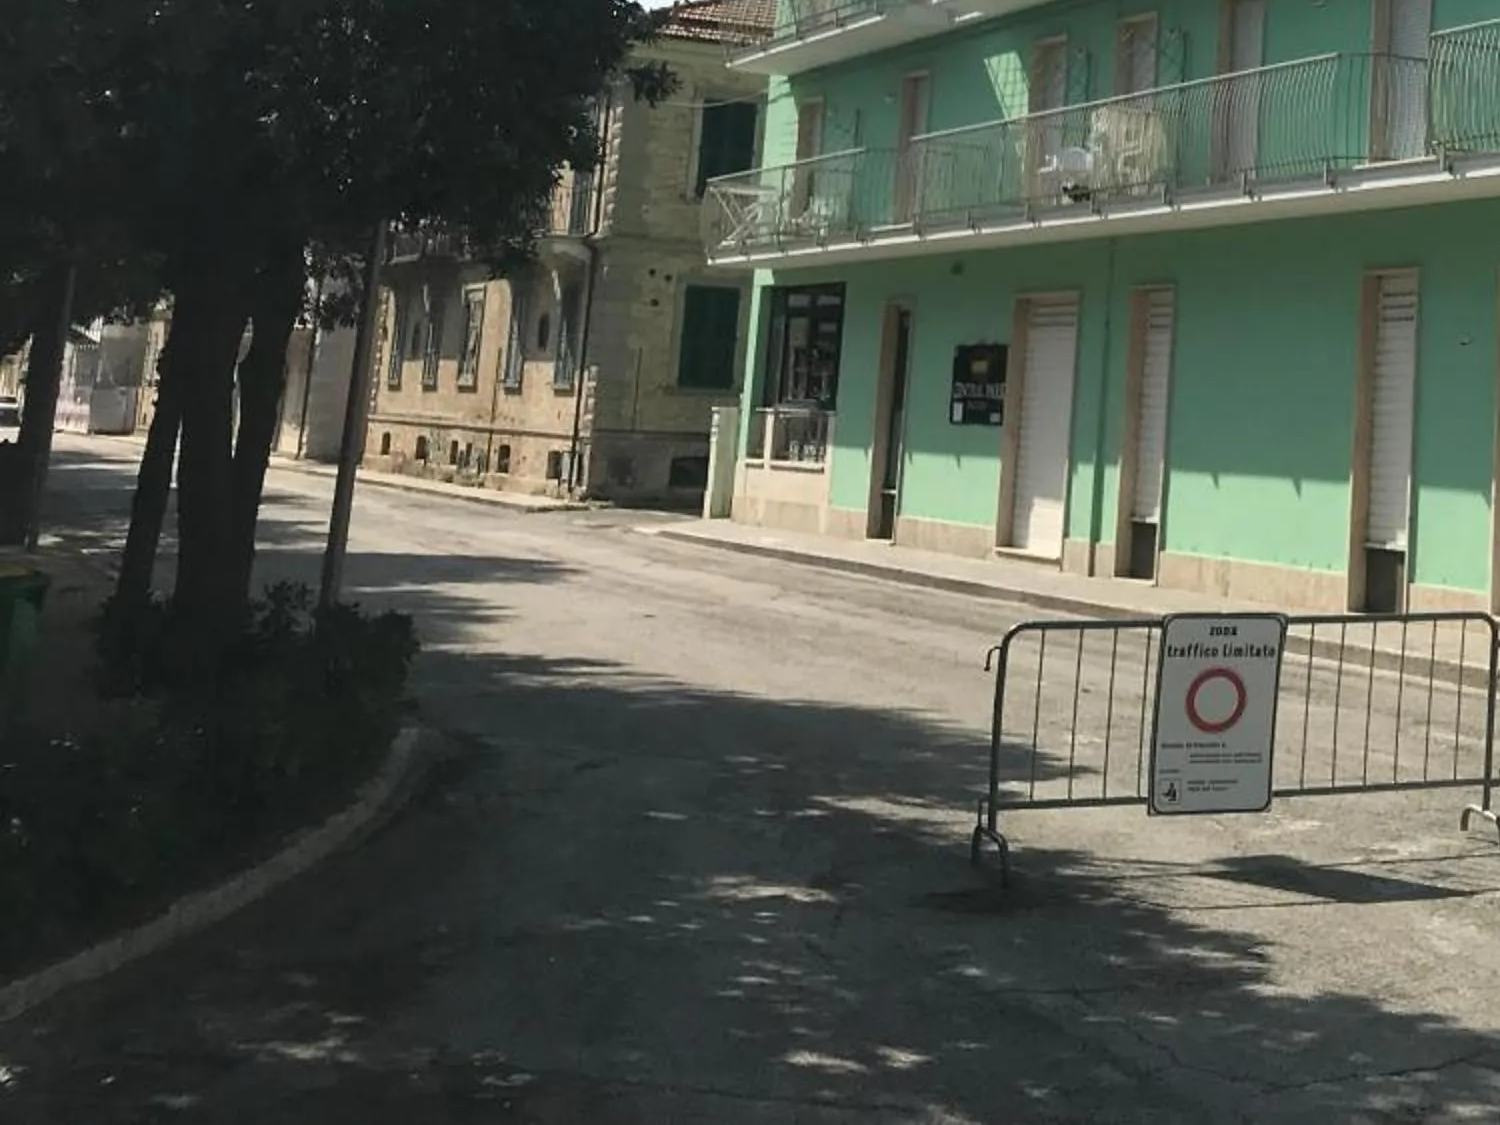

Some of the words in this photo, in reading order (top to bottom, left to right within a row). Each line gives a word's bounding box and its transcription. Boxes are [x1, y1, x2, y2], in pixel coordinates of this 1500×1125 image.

[1208, 626, 1238, 636] zona
[1167, 643, 1219, 658] traffico
[1223, 643, 1276, 658] limitato
